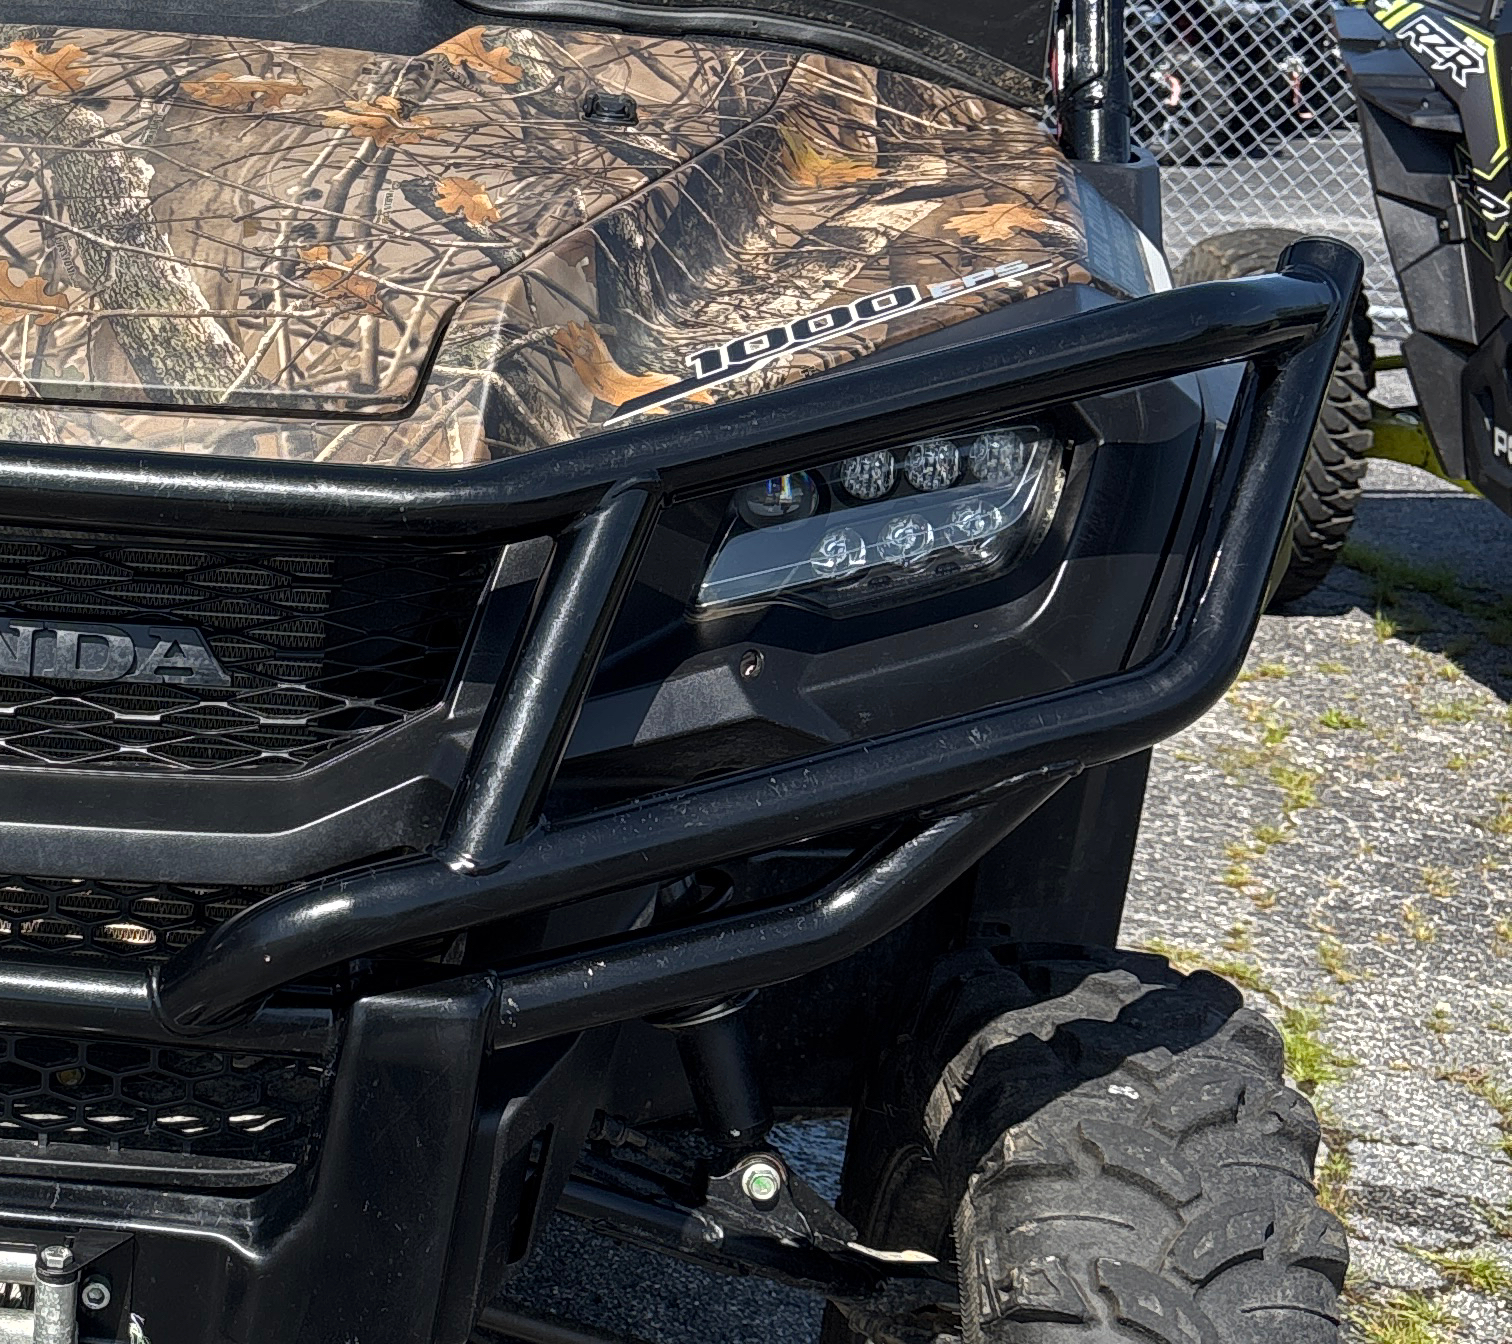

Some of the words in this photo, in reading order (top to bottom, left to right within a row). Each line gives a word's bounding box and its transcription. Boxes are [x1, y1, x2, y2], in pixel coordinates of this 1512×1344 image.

[1395, 14, 1485, 88] RZR
[685, 284, 923, 380] 1000
[927, 259, 1030, 299] EPS
